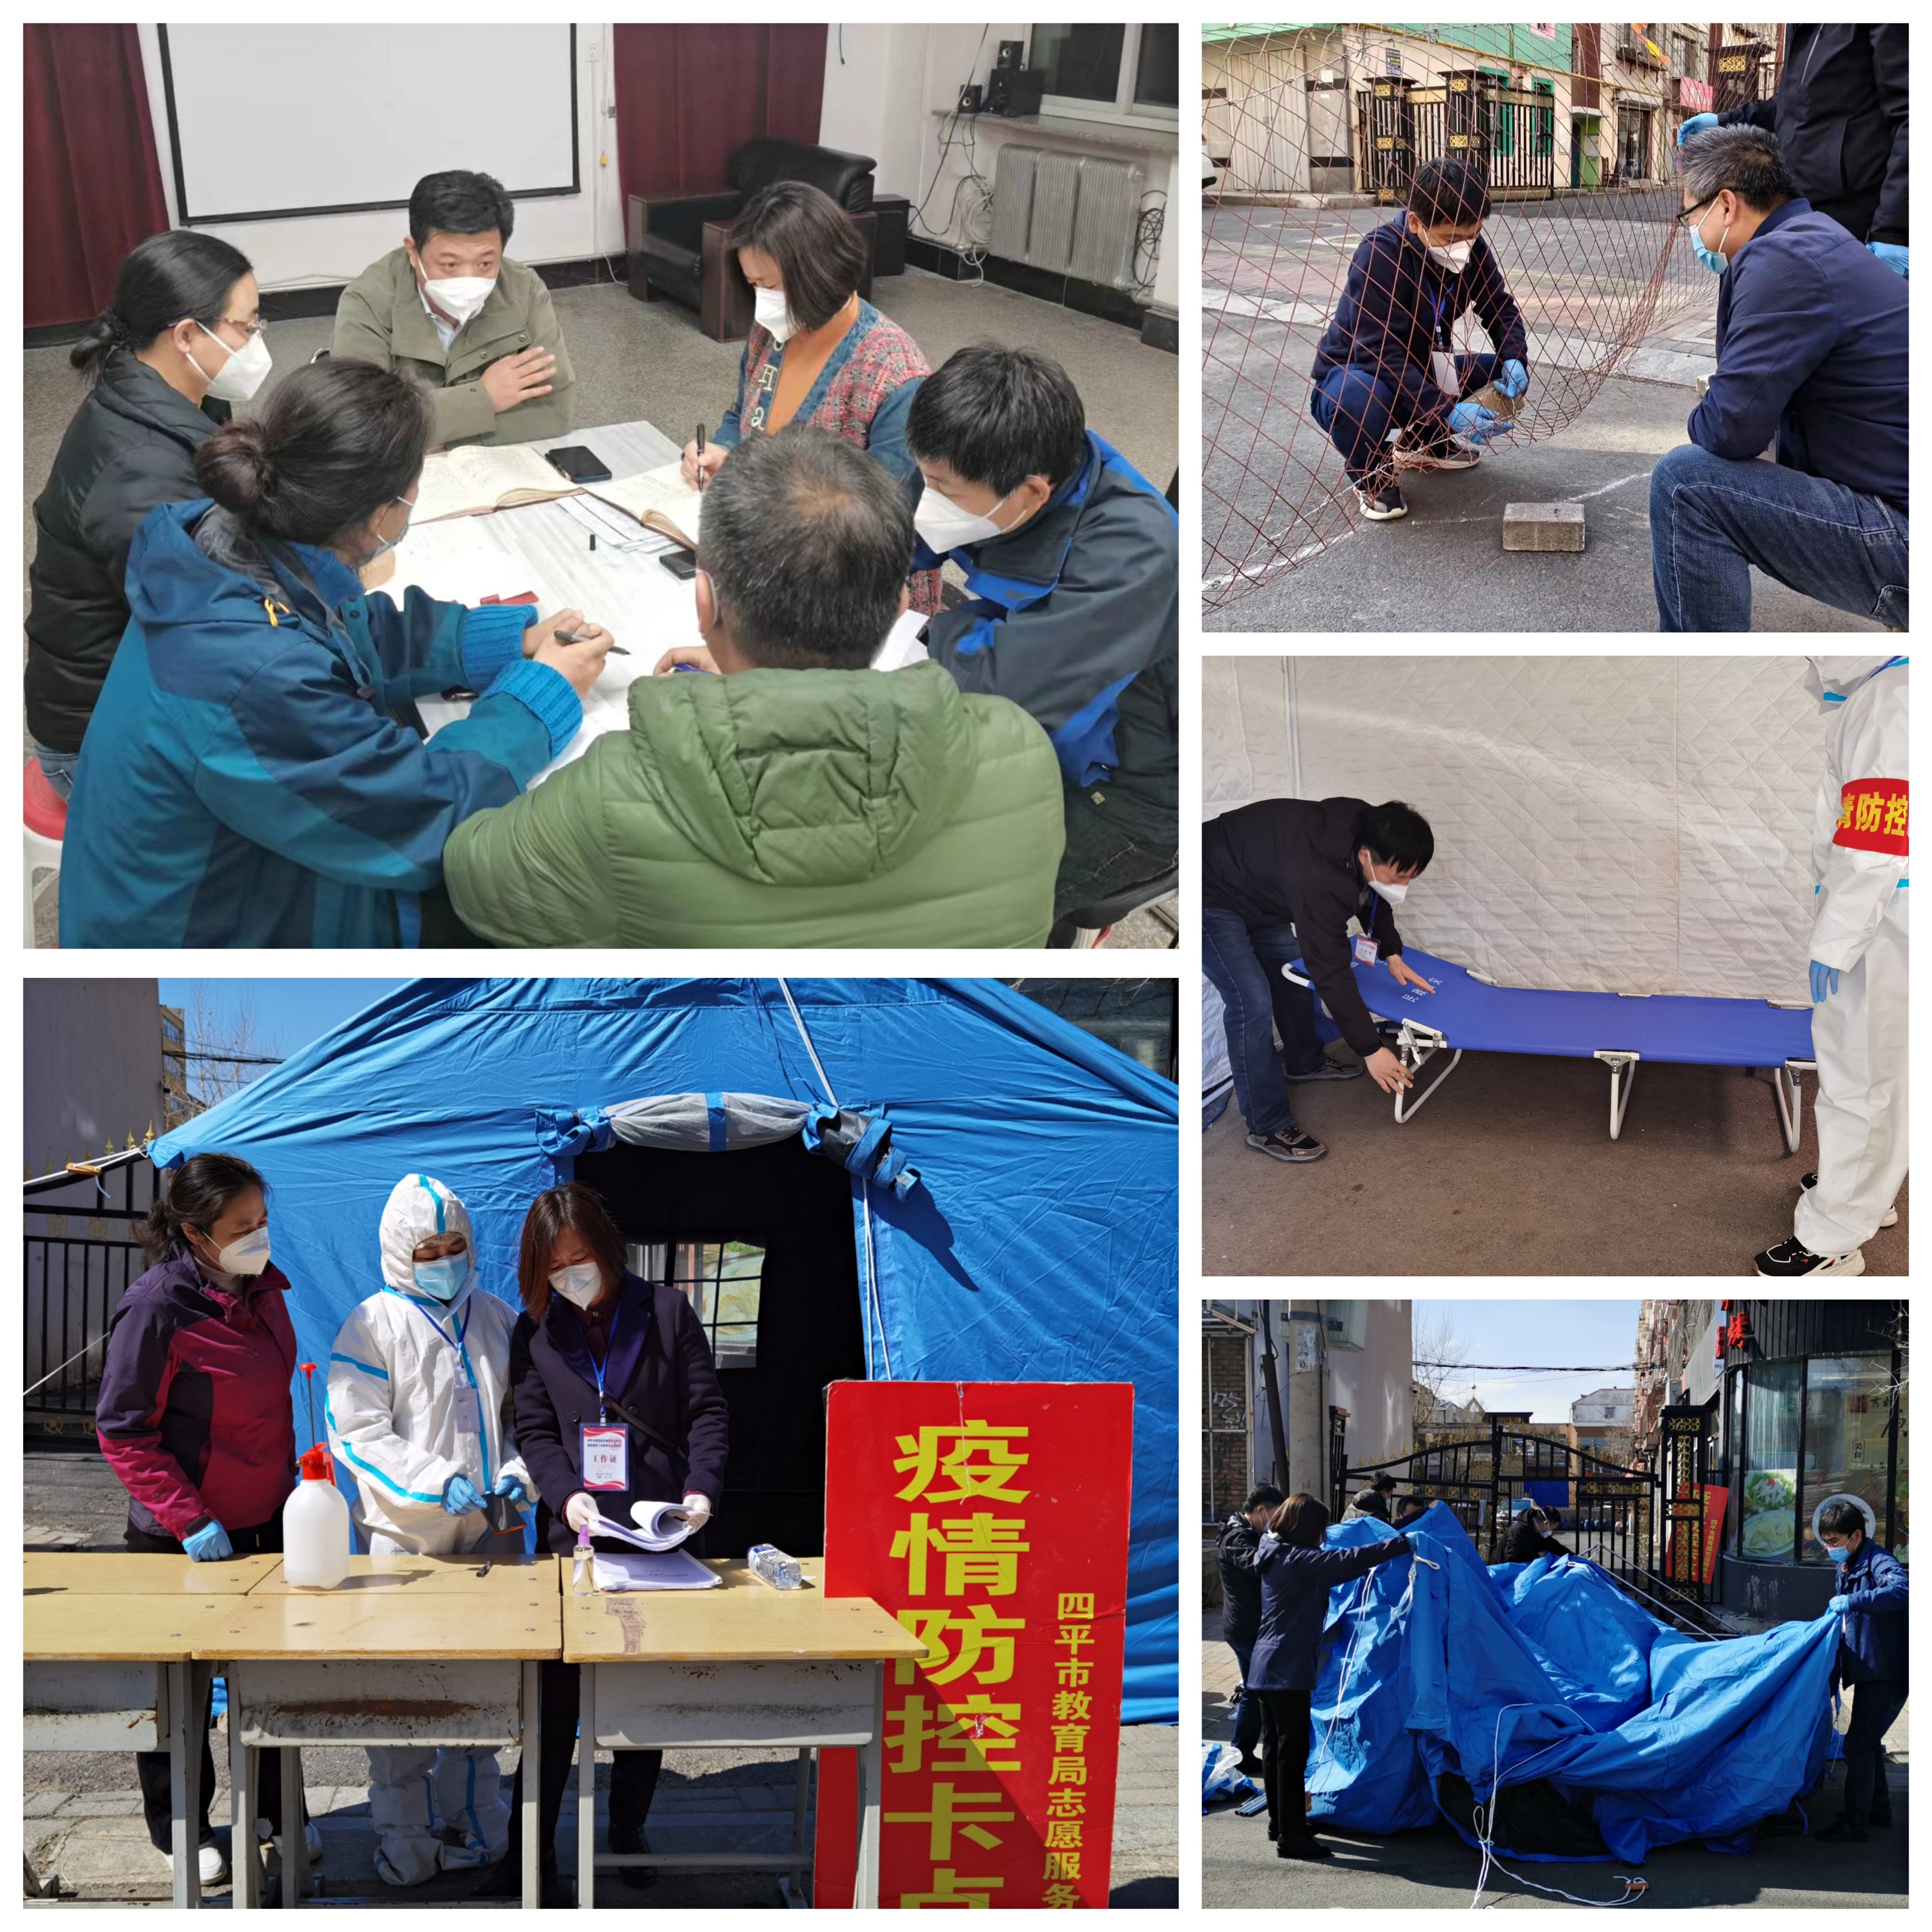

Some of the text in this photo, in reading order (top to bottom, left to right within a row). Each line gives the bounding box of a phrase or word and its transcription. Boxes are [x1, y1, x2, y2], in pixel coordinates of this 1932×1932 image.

[1402, 977, 1443, 1003] 民政灾
[591, 1455, 618, 1463] 工作证
[1041, 1592, 1095, 1908] 四平市教育局志愿服务
